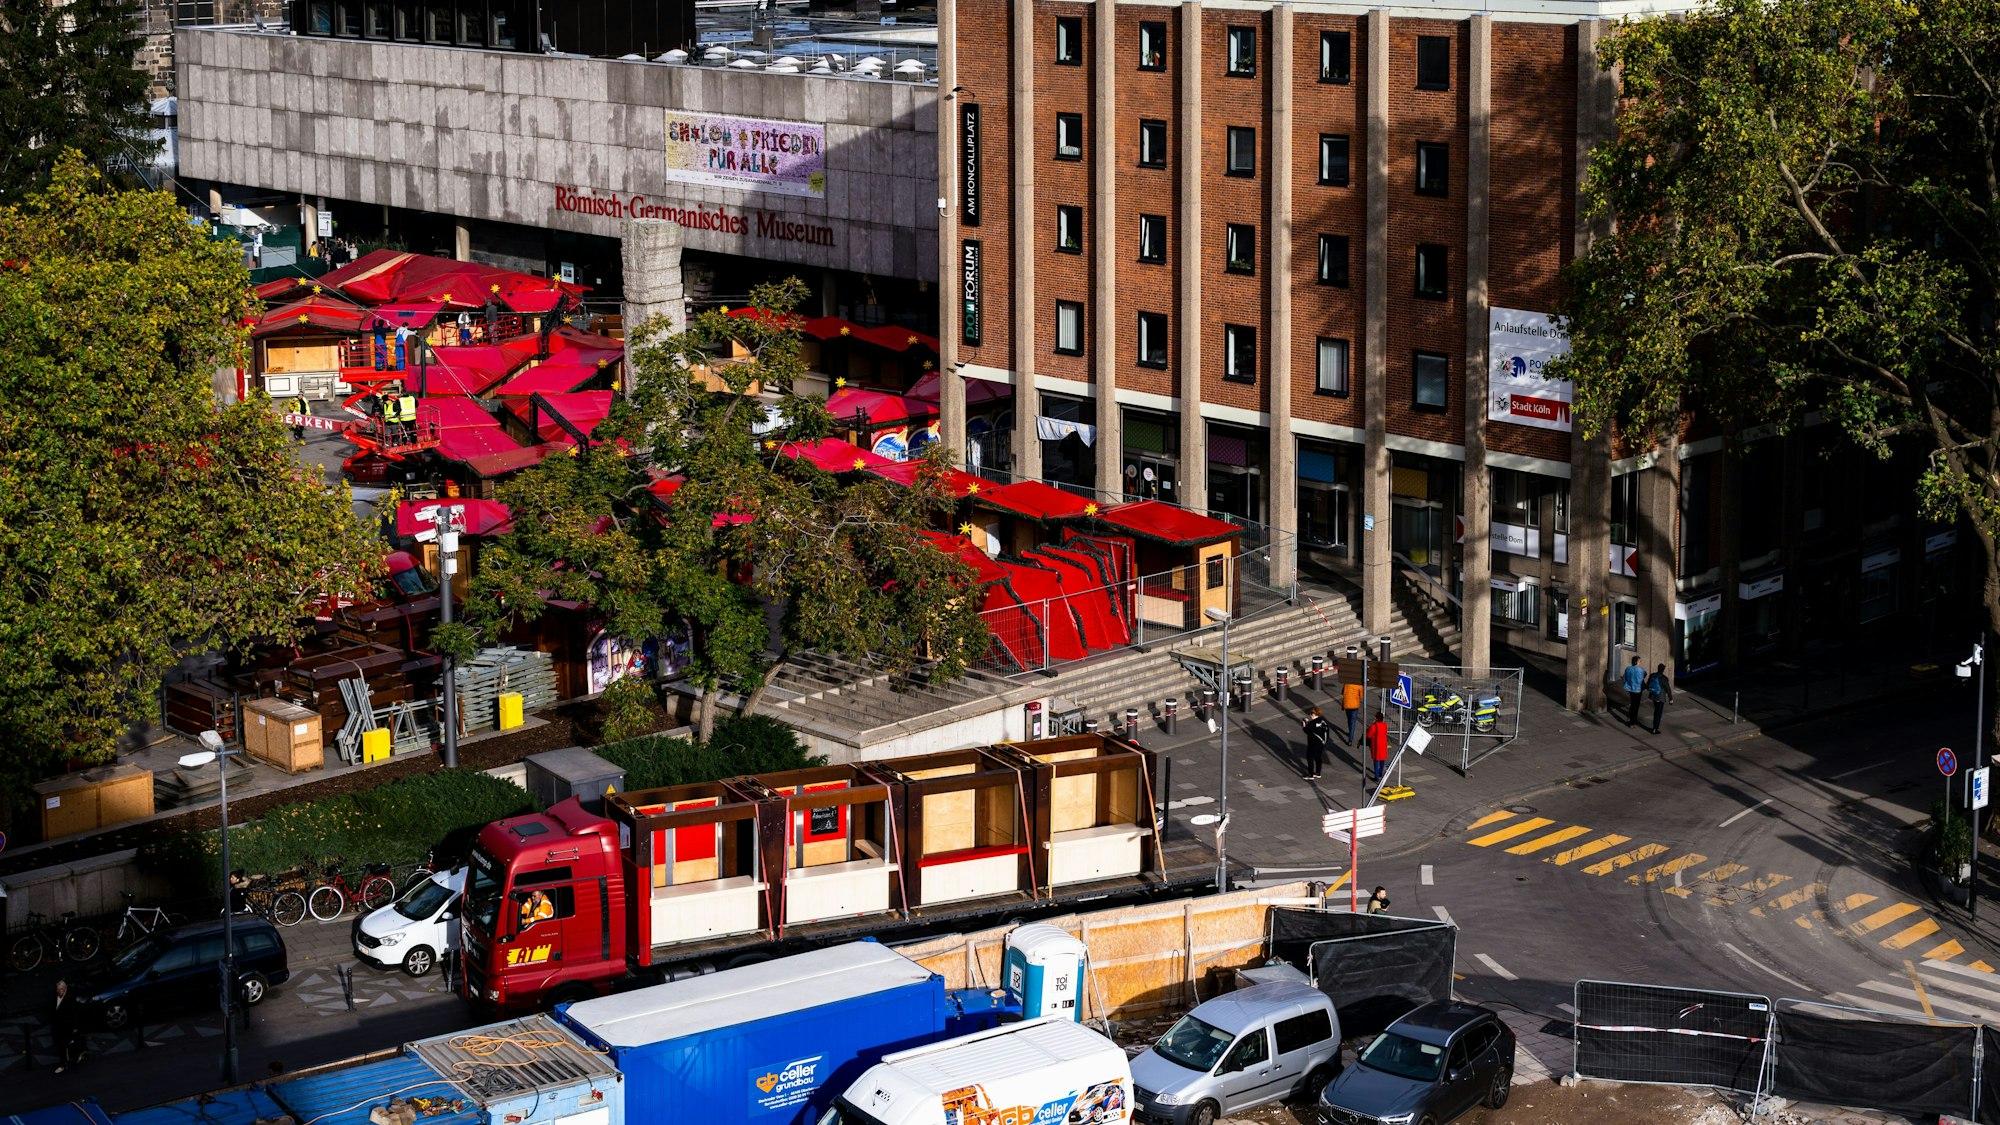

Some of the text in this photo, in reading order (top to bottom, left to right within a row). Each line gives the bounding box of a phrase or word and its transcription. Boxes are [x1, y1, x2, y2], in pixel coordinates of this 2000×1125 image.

[967, 112, 976, 216] AM RONCALLIPLATZ
[555, 185, 837, 247] Römisch-Germanisches Museum
[1494, 321, 1548, 338] Anlaufstelle
[1511, 400, 1551, 415] Stadt Köln
[1508, 535, 1523, 544] Dom
[1056, 983, 1067, 991] TOI
[780, 1063, 818, 1082] celler
[775, 1077, 814, 1093] grundbau
[1038, 1102, 1069, 1120] celler
